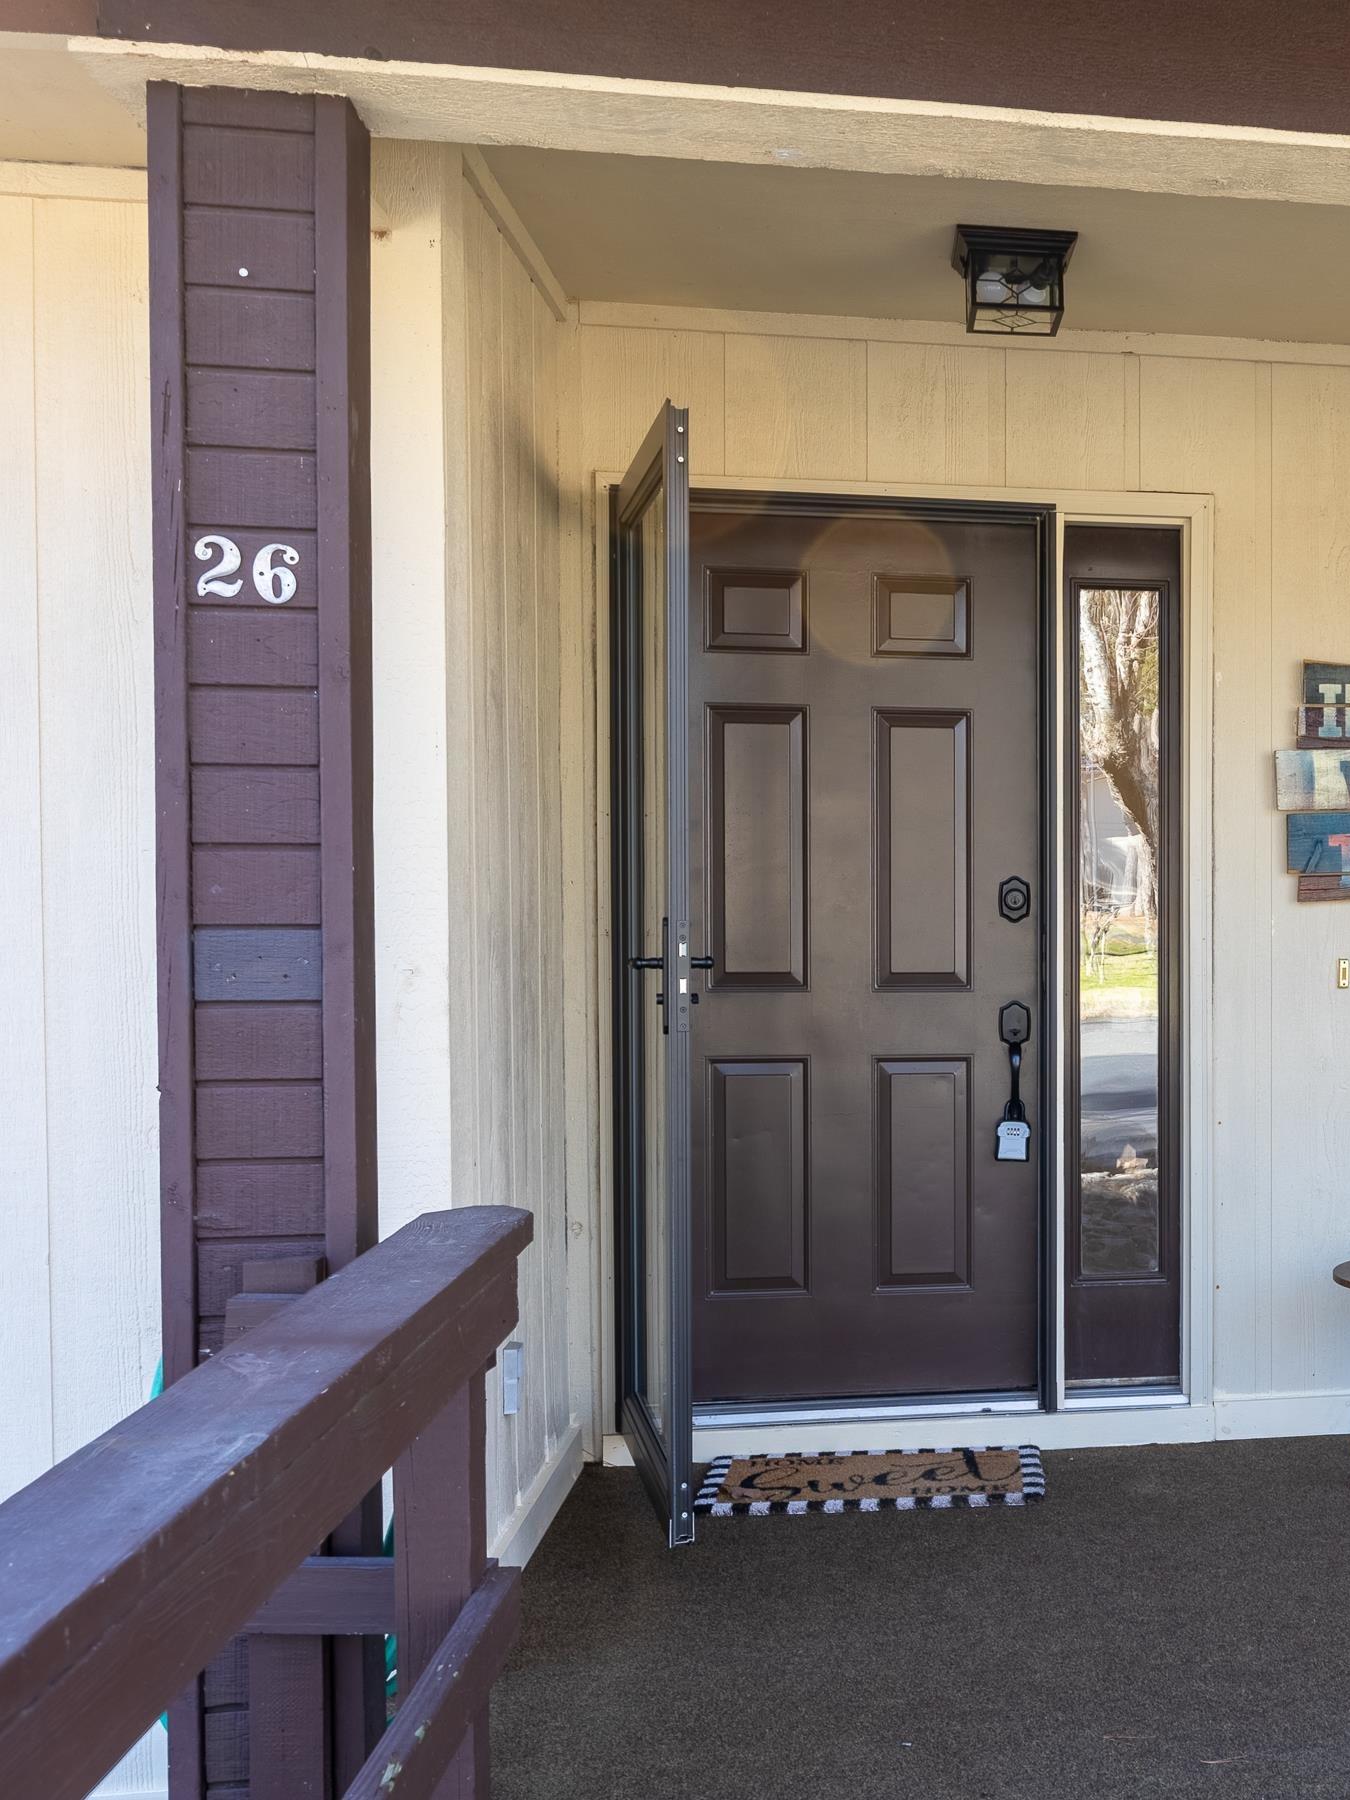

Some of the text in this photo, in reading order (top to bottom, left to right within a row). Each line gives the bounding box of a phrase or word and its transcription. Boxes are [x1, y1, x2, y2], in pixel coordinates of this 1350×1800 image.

[194, 534, 300, 605] 26
[738, 1449, 1020, 1501] Sweet
[750, 1456, 846, 1468] HOME
[909, 1484, 1010, 1496] HOME
